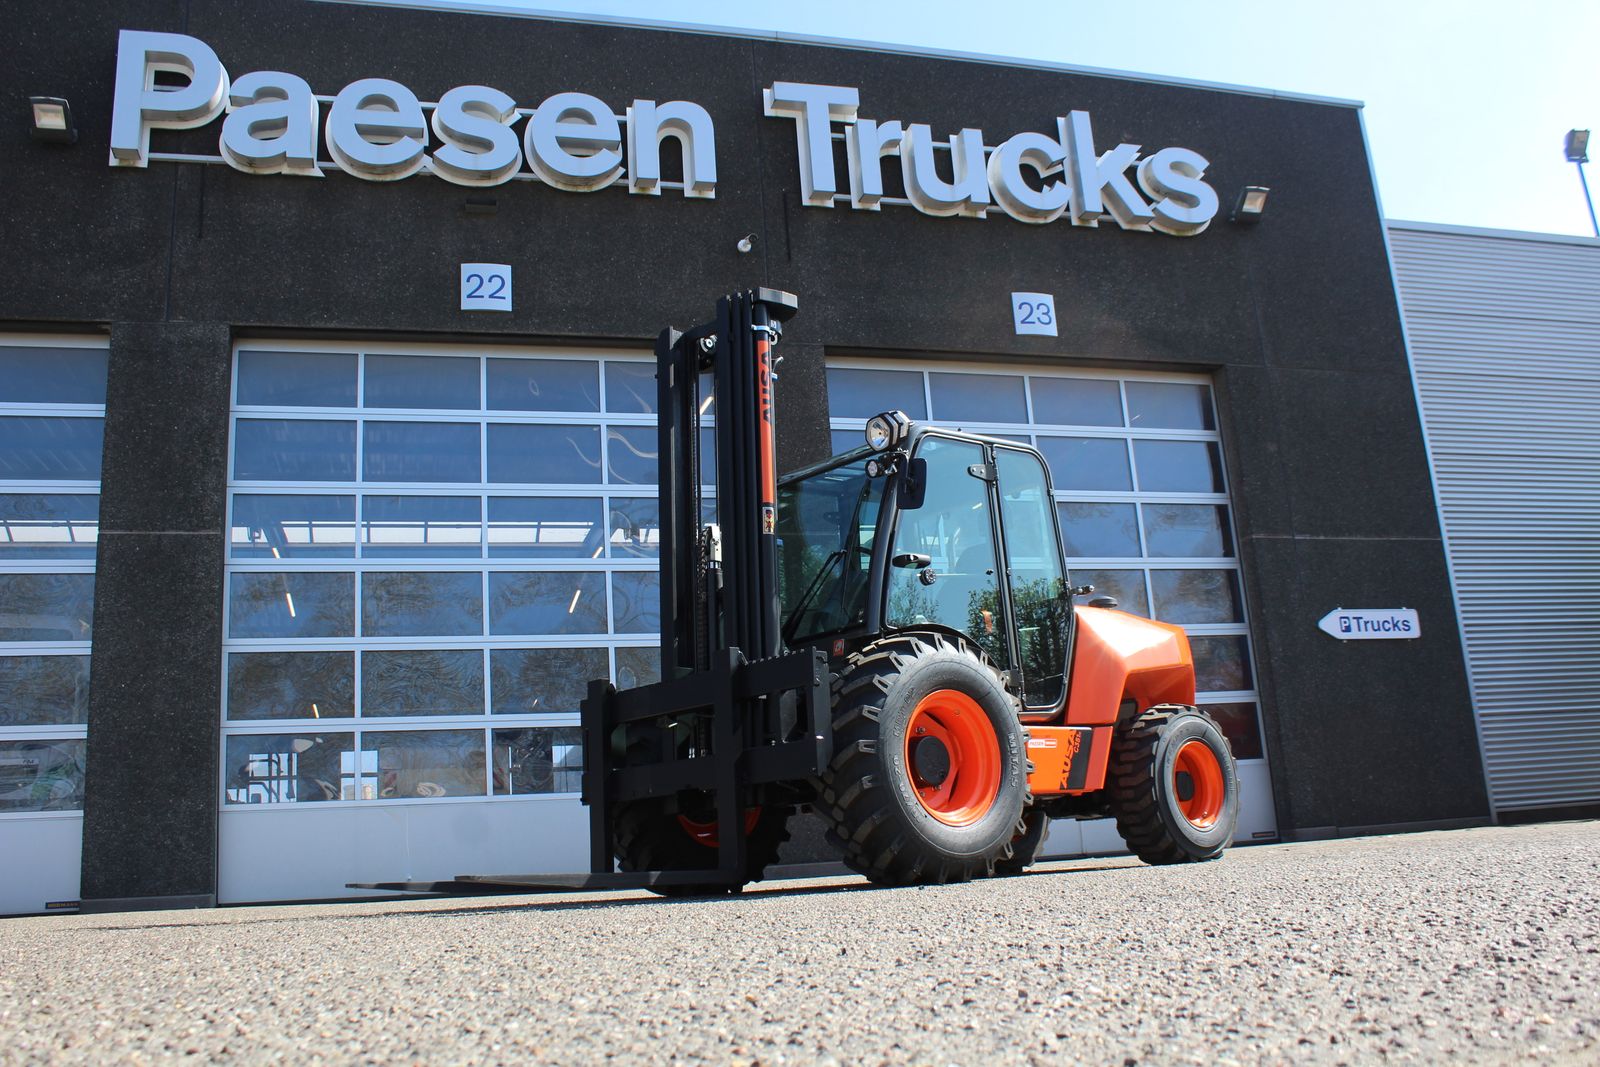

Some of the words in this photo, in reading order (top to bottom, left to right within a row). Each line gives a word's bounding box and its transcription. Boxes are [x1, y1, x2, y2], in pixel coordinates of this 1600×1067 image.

[109, 29, 718, 198] Paesen
[763, 81, 1220, 237] Trucks
[466, 273, 506, 300] 22
[1018, 302, 1052, 326] 23
[1352, 616, 1412, 632] Trucks
[1060, 728, 1077, 790] AUSA
